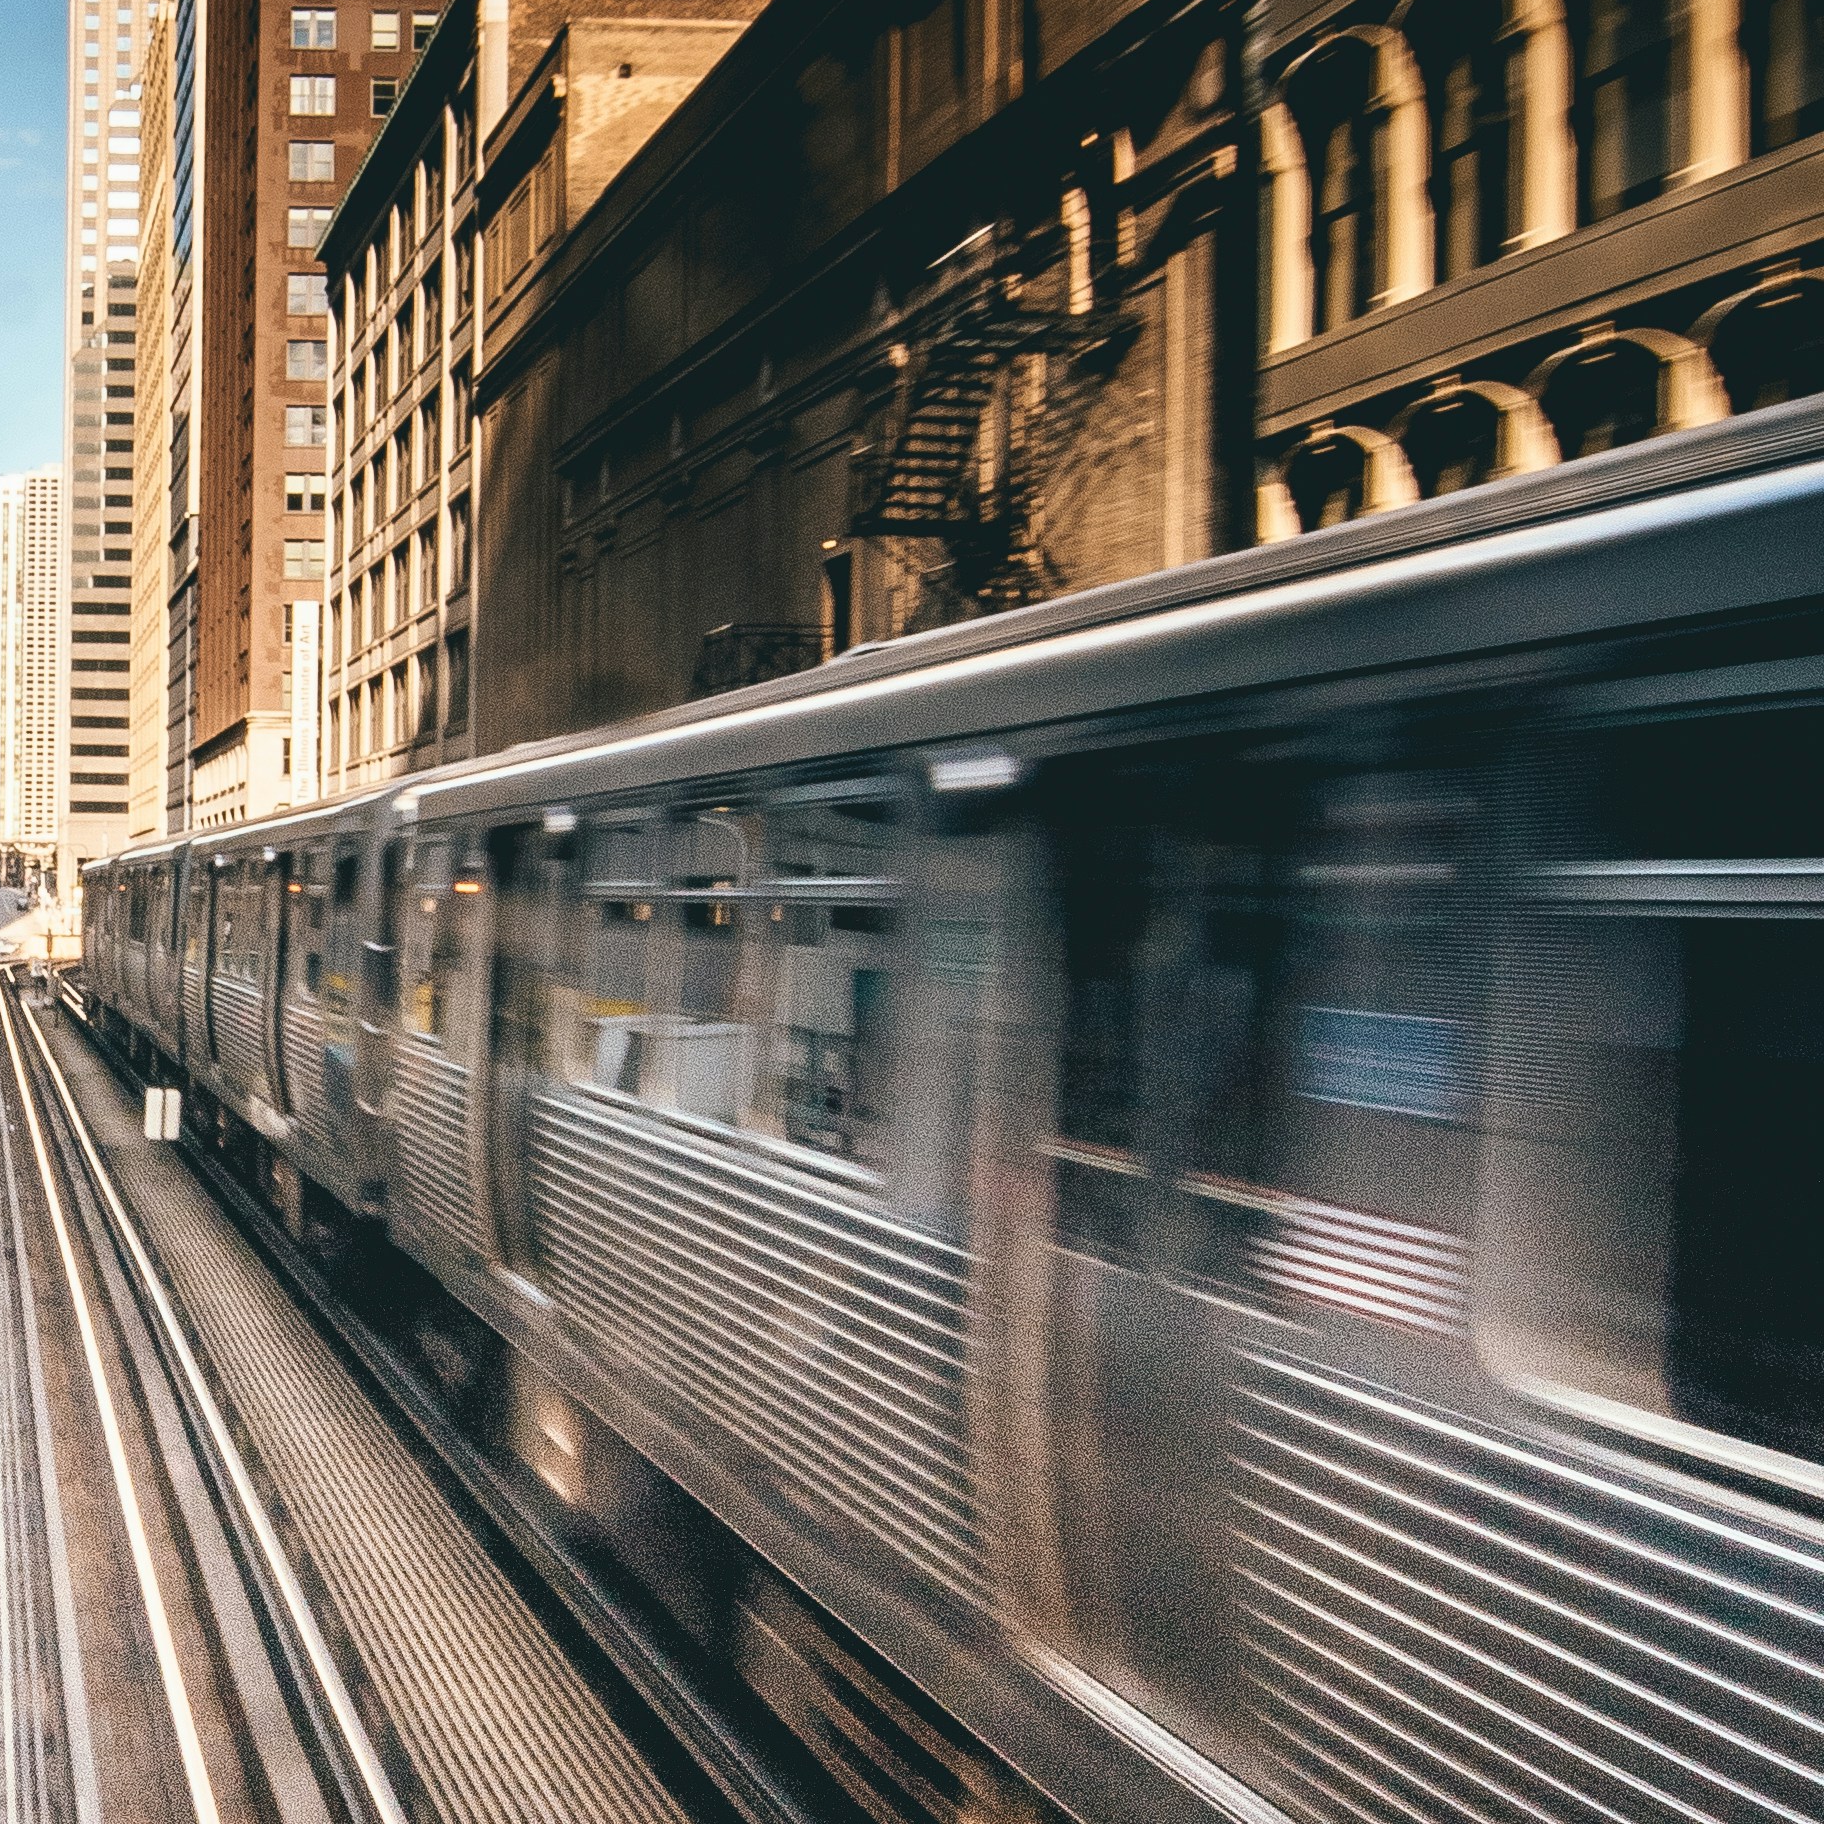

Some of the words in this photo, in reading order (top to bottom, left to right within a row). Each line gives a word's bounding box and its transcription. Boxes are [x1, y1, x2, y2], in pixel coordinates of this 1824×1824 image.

[298, 623, 311, 644] Art
[297, 666, 311, 722] Institute
[296, 727, 310, 772] Illinois
[297, 778, 309, 800] The
